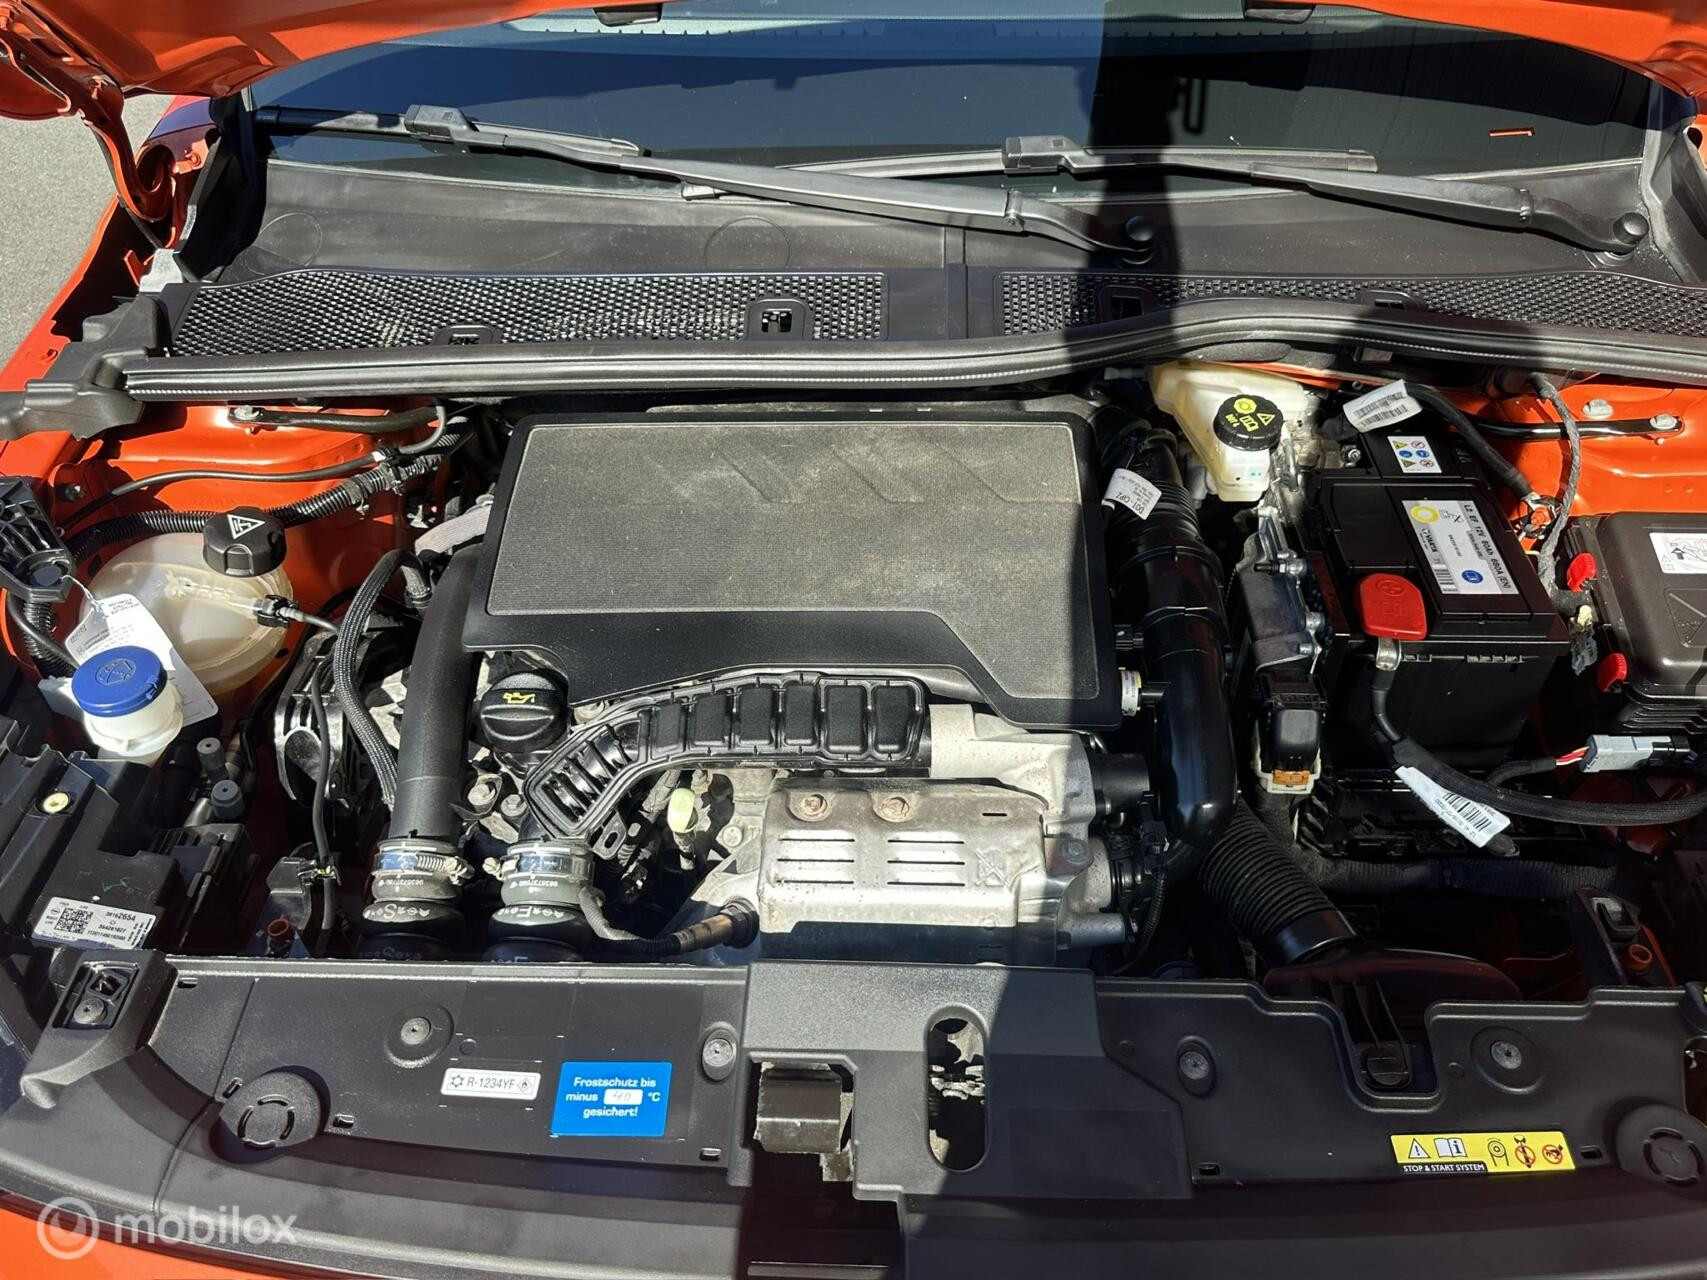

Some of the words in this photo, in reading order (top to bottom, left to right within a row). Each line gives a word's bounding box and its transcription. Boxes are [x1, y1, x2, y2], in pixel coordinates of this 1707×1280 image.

[1132, 501, 1145, 515] DOT
[1475, 526, 1487, 538] 12V
[1425, 529, 1439, 553] VARTA
[466, 1076, 515, 1089] R-1234YF
[573, 1076, 638, 1087] Frostschutz
[640, 1077, 656, 1087] bis
[565, 1092, 598, 1101] minus
[583, 1106, 639, 1119] gesichert!
[1403, 1164, 1423, 1172] STOP
[1431, 1164, 1454, 1172] START
[1455, 1163, 1485, 1171] SYSTEM
